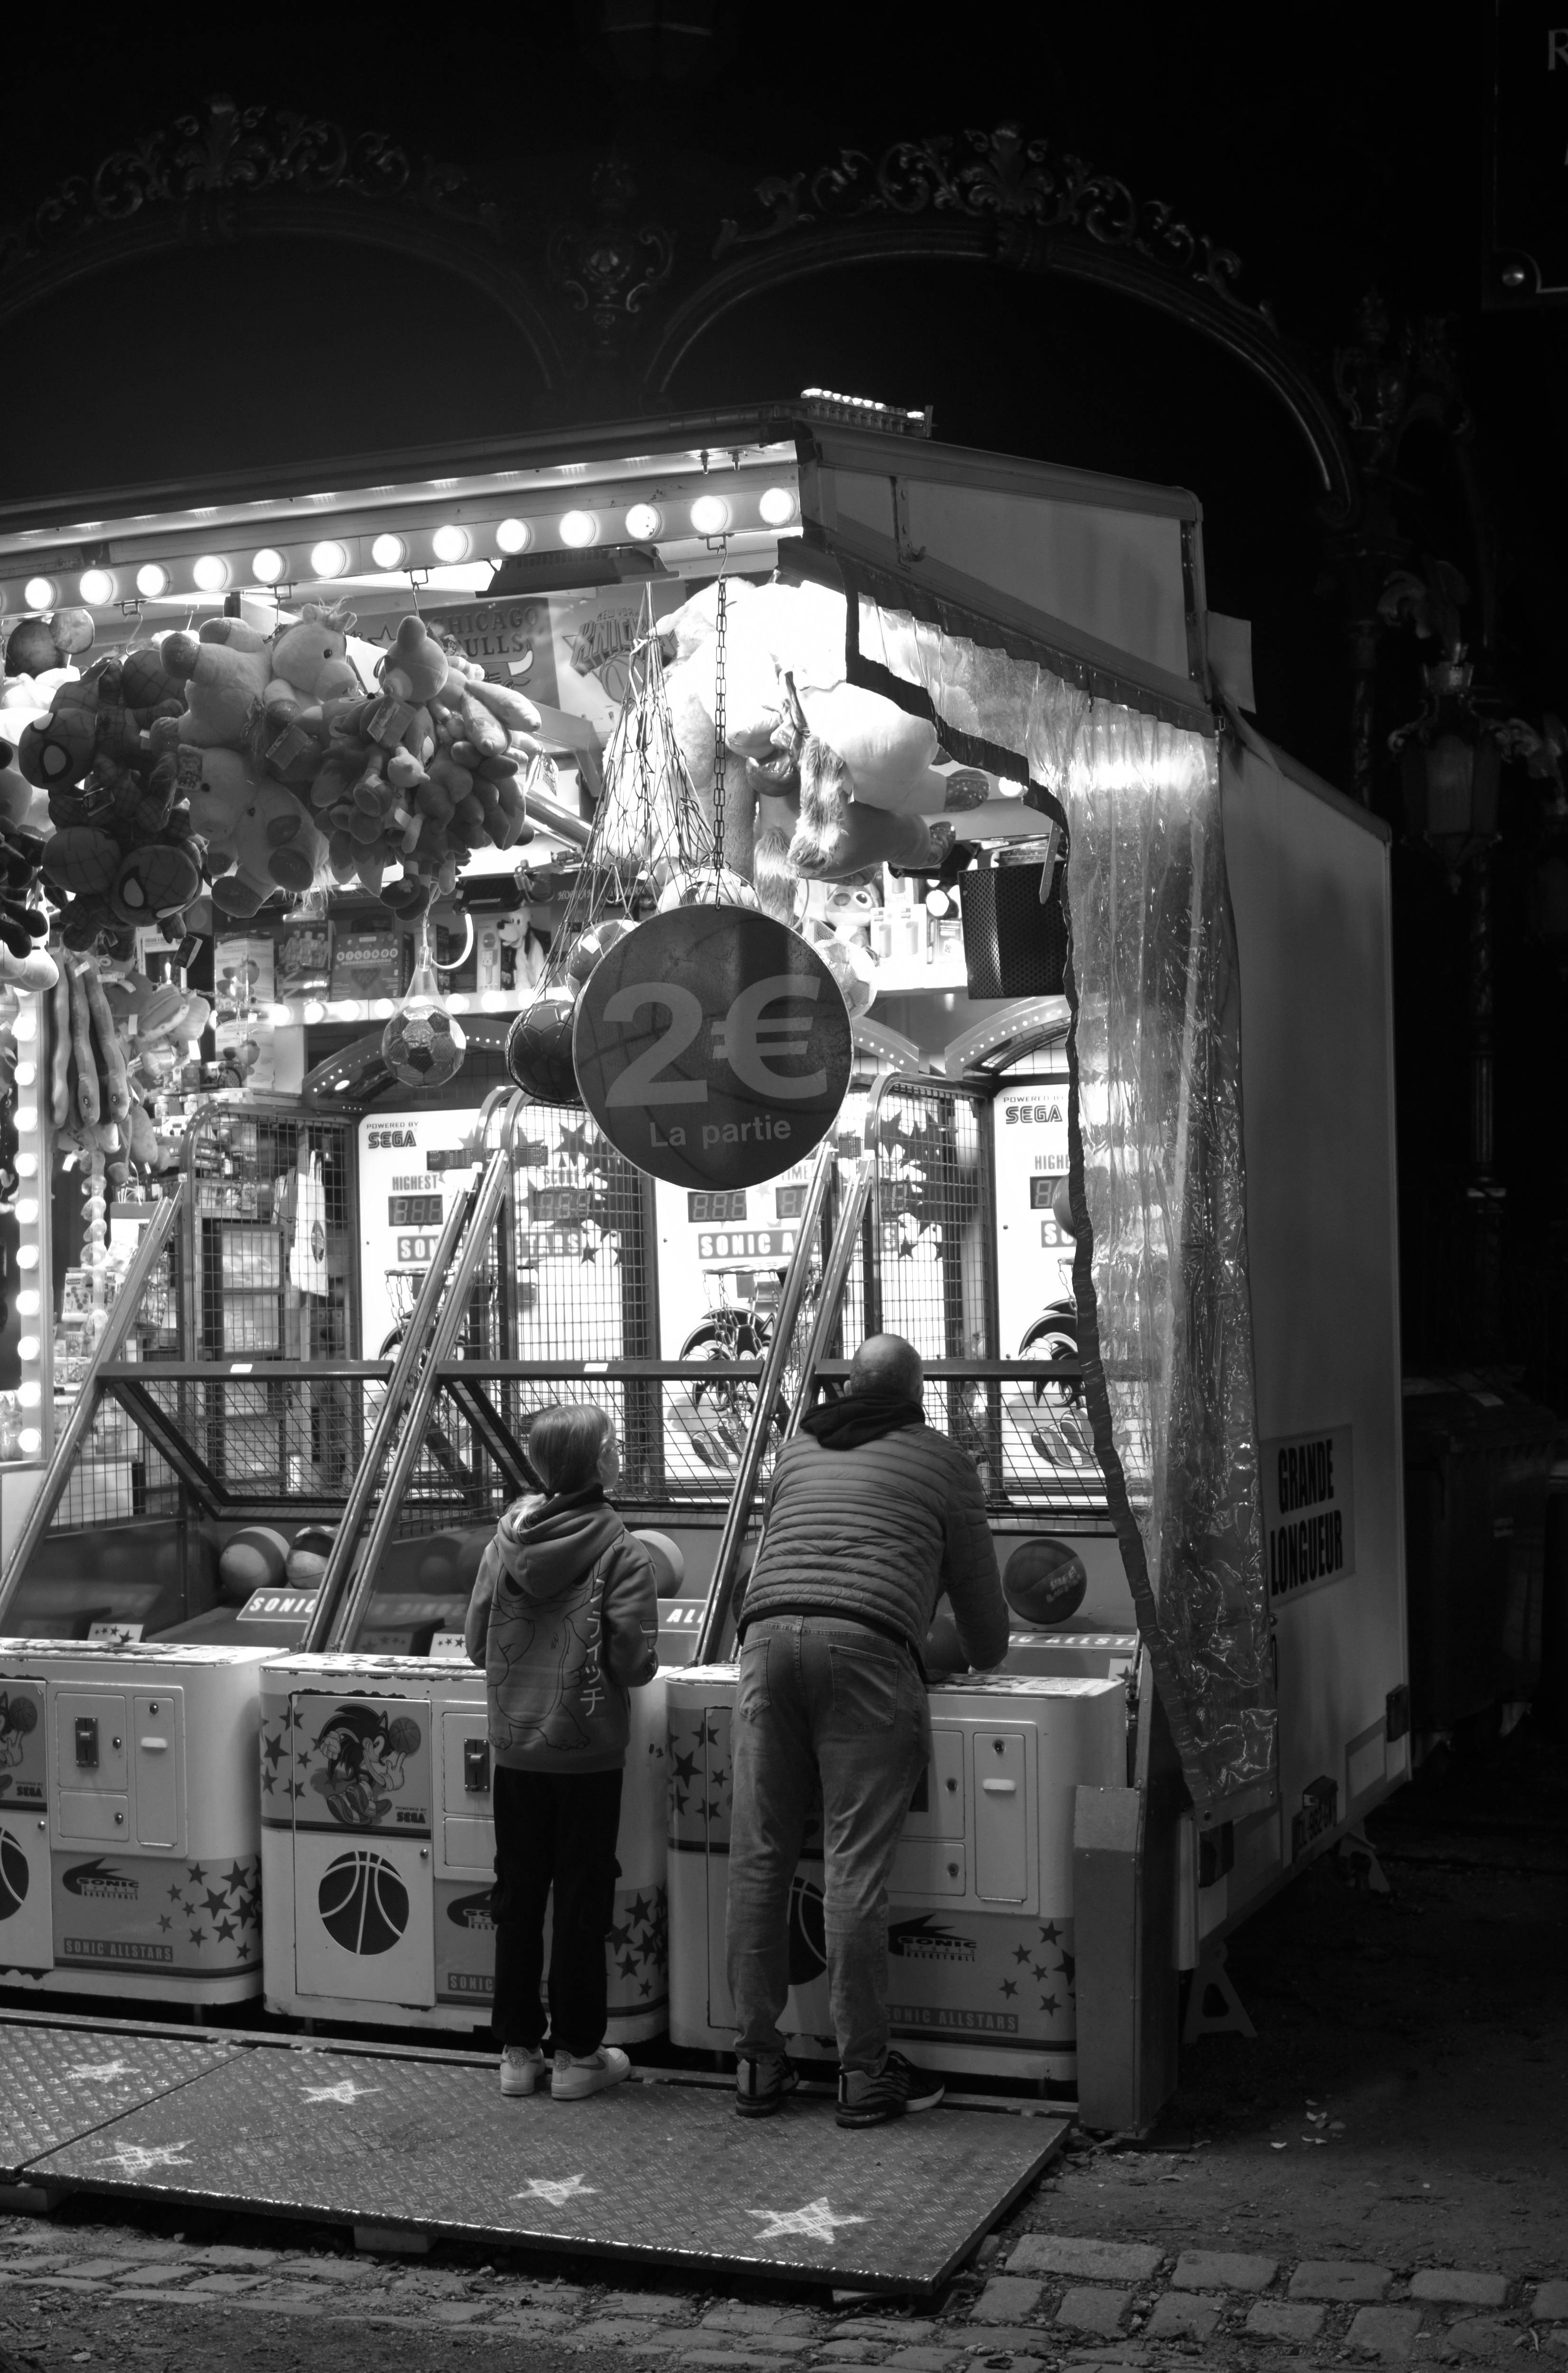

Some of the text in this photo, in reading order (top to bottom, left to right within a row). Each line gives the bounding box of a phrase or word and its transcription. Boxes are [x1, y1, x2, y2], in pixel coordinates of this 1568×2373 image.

[465, 632, 523, 657] ULLS
[603, 974, 827, 1107] 2€
[1005, 1104, 1063, 1124] SEGA
[368, 1130, 417, 1149] SEGA
[649, 1122, 686, 1147] La
[702, 1115, 792, 1149] partie
[392, 1175, 438, 1191] HIGHEST
[700, 1233, 771, 1257] SONIC
[1278, 1439, 1335, 1514] GRANDE
[1270, 1509, 1343, 1597] LONGUEUR
[17, 1786, 43, 1798] SEGA
[397, 1812, 426, 1823] SEGA
[78, 1878, 140, 1888] SONIC
[84, 1891, 138, 1900] BASKETBALL
[66, 1940, 172, 1960] SONIC ALLSTARS
[899, 1937, 977, 1949] SONIC
[907, 1951, 975, 1962] BASKETBALL
[450, 1975, 493, 1991] SONIC
[885, 2007, 1016, 2030] SONIC ALLSTARS
